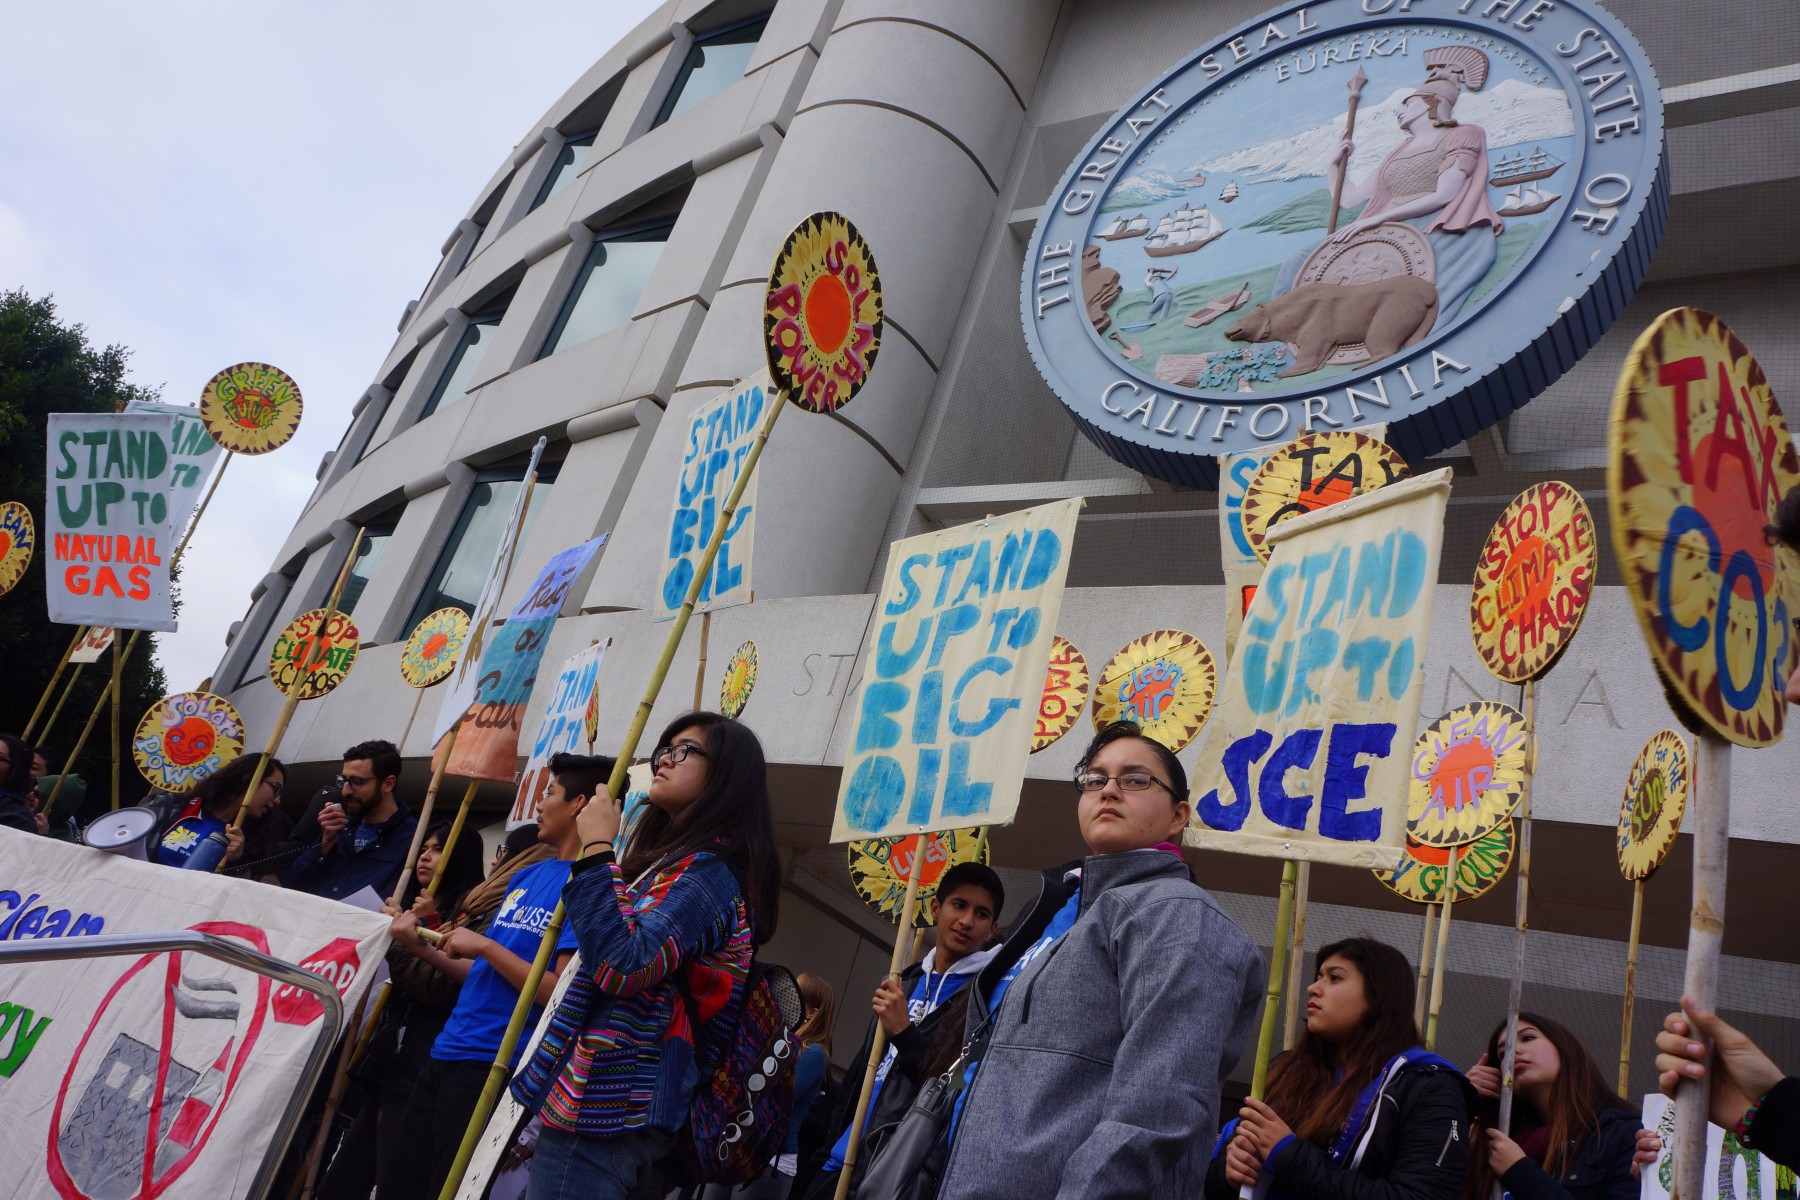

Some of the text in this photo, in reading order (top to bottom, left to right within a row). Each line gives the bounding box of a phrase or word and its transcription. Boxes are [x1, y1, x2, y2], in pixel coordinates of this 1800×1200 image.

[1276, 36, 1409, 83] EUREKA
[1556, 28, 1640, 144] STATE
[1037, 8, 1319, 320] THE GREAT SEAL
[1570, 172, 1633, 236] OF
[768, 281, 839, 412] POWER
[826, 240, 874, 386] SOLAR
[215, 368, 298, 408] GREEN
[222, 394, 280, 429] FUTURE
[684, 386, 764, 465] STAND
[1100, 350, 1471, 441] CALIFORNIA
[56, 430, 168, 480] STAND
[171, 420, 216, 457] AND
[1659, 355, 1782, 513] TAX
[56, 482, 167, 529] UP TO
[169, 463, 201, 489] TO
[678, 449, 730, 508] UP
[0, 509, 32, 549] EAN
[54, 532, 161, 567] NATURAL
[1487, 482, 1560, 580] STOP
[64, 565, 152, 601] GAS
[885, 527, 1063, 616] STAND
[1247, 526, 1428, 641] STAND
[1477, 513, 1591, 633] CLIMATE
[296, 614, 360, 644] SOP
[876, 603, 1042, 680] UP TO
[1500, 565, 1591, 666] CHAOS
[856, 656, 1021, 754] BIG
[1033, 637, 1073, 737] POWE
[1241, 628, 1341, 718] UP
[1343, 636, 1415, 702] TO
[842, 739, 994, 834] OIL
[1195, 723, 1398, 842] SCE
[1413, 715, 1524, 782] CLEAN
[1418, 765, 1509, 823] AIR
[1621, 757, 1647, 849] REACH
[1667, 751, 1682, 795] THE
[893, 839, 948, 876] LIES
